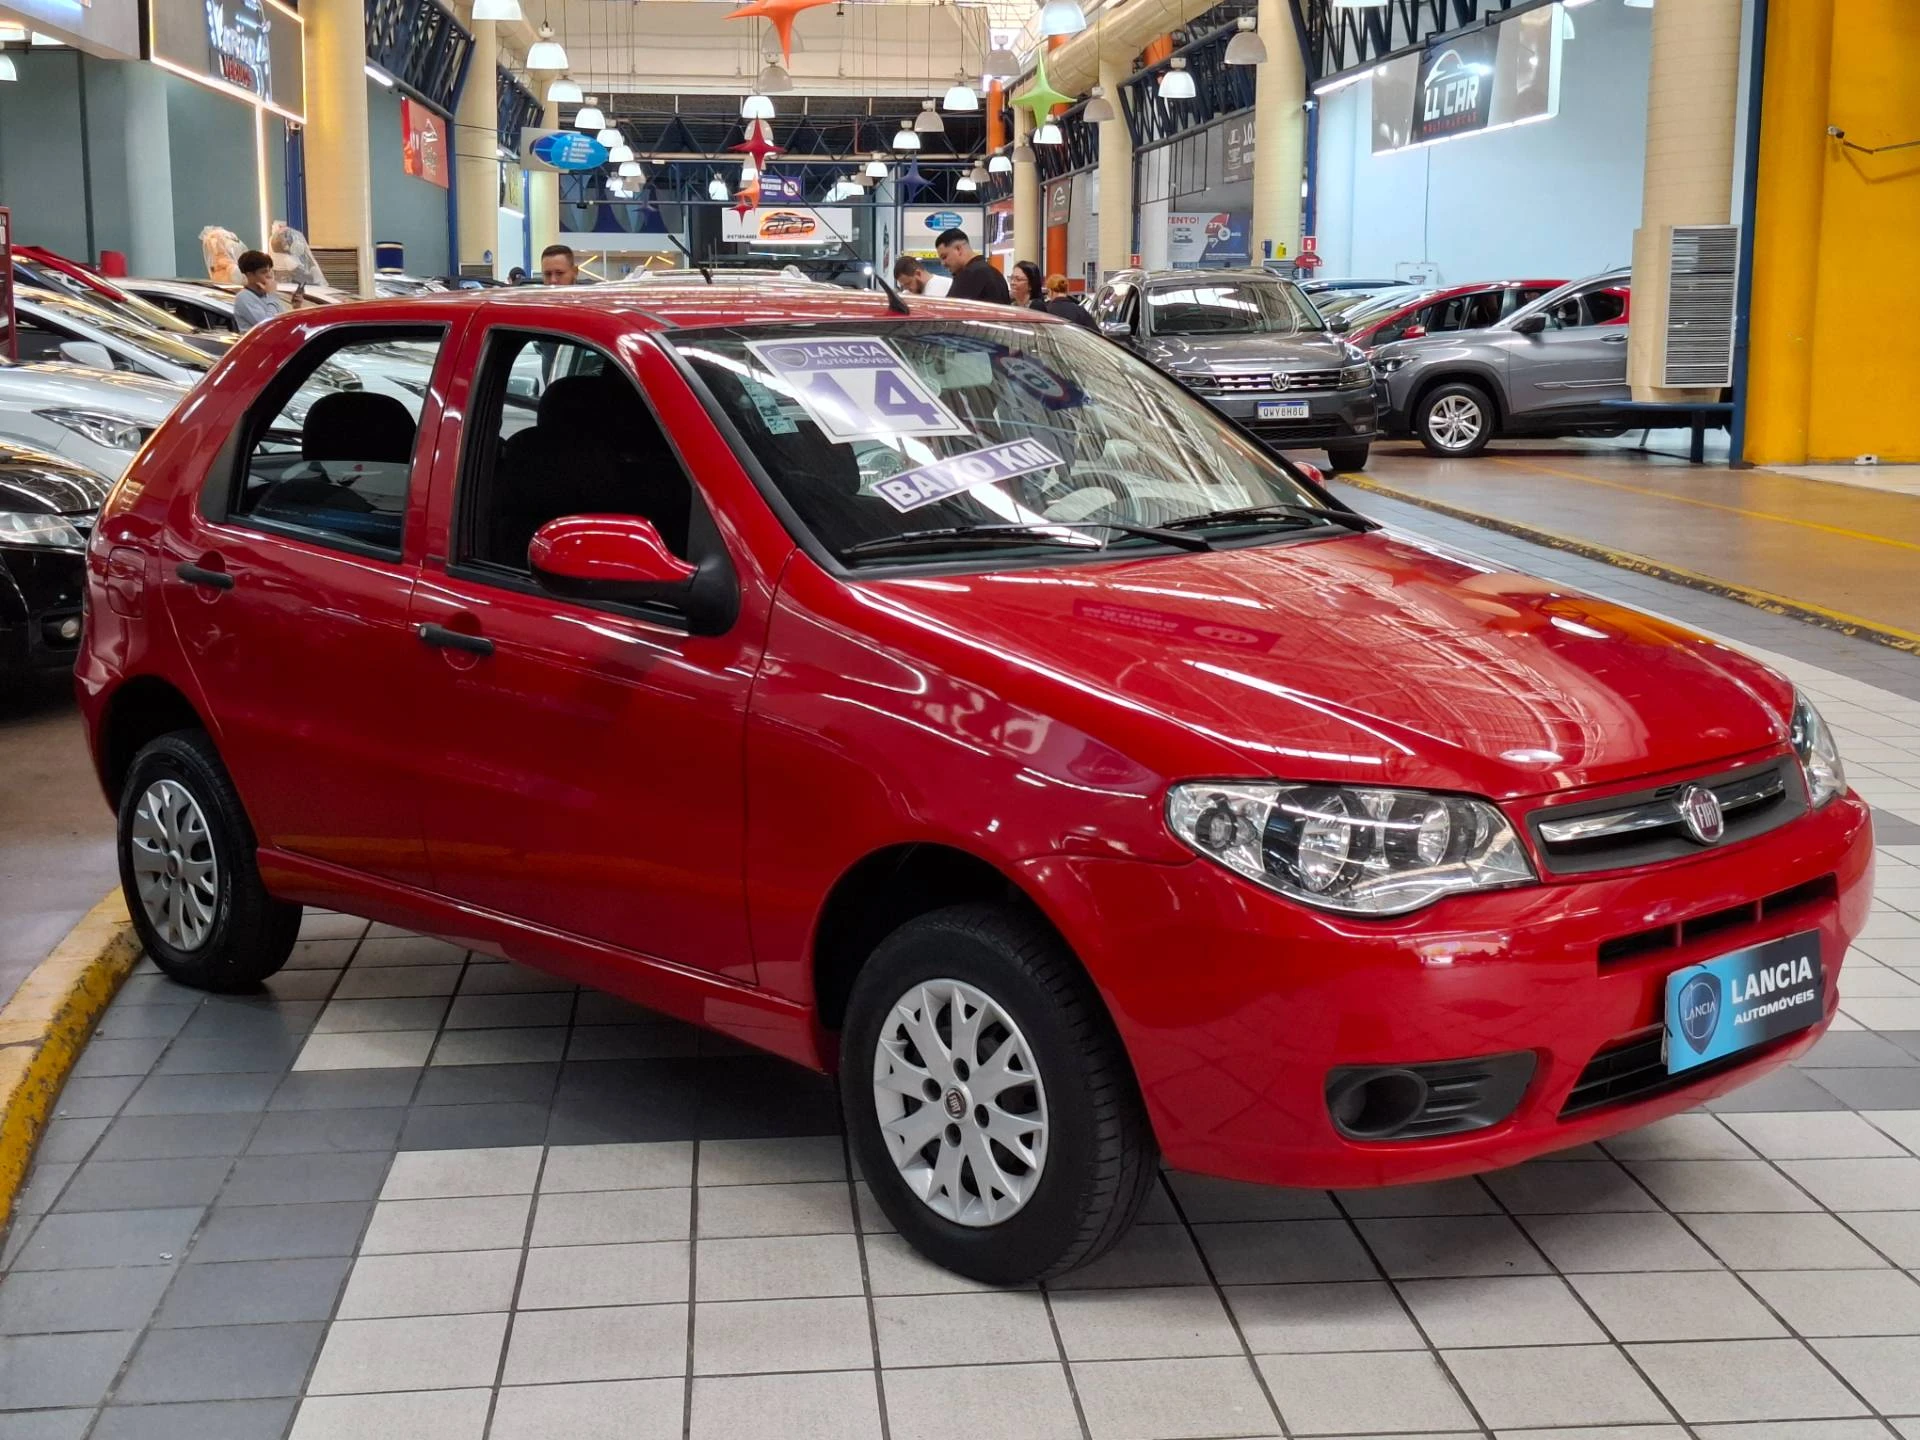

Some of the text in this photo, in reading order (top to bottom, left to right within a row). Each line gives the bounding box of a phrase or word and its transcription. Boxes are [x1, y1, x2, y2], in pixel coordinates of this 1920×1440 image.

[1424, 75, 1480, 122] LL CAR
[803, 345, 887, 358] LANCIA
[805, 370, 942, 430] 14
[881, 442, 1053, 507] BAIXO KM
[1695, 801, 1718, 829] FIAT
[1731, 956, 1813, 1005] LANCIA
[1684, 1001, 1716, 1021] LANCIA
[1733, 988, 1815, 1026] AUTOMÓVEIS
